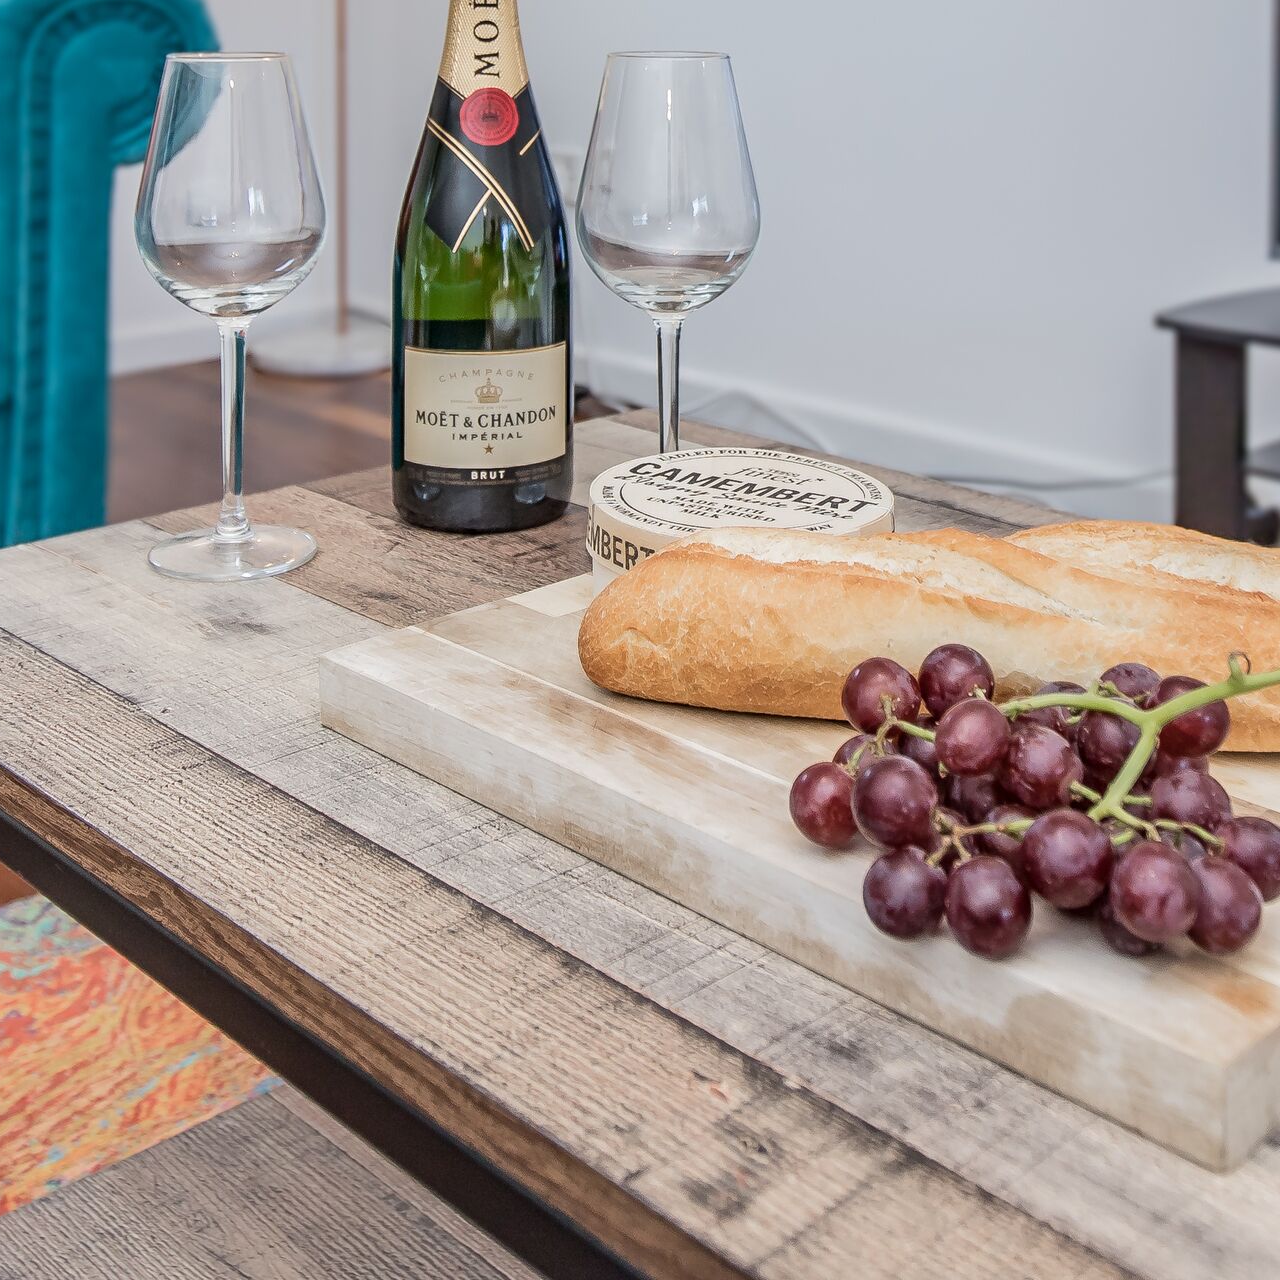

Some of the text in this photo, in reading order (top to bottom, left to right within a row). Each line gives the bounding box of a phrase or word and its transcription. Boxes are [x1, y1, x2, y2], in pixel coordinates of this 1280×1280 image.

[438, 368, 535, 383] CHAMPAGNE
[463, 416, 474, 428] &
[477, 405, 557, 428] CHANDON
[452, 431, 524, 441] IMPÉRIAL
[657, 449, 715, 462] LADLED
[752, 450, 783, 458] THE
[470, 470, 506, 481] BRUT
[628, 462, 879, 513] CAMEMBERT
[679, 508, 721, 520] MILK
[722, 503, 767, 516] WITH
